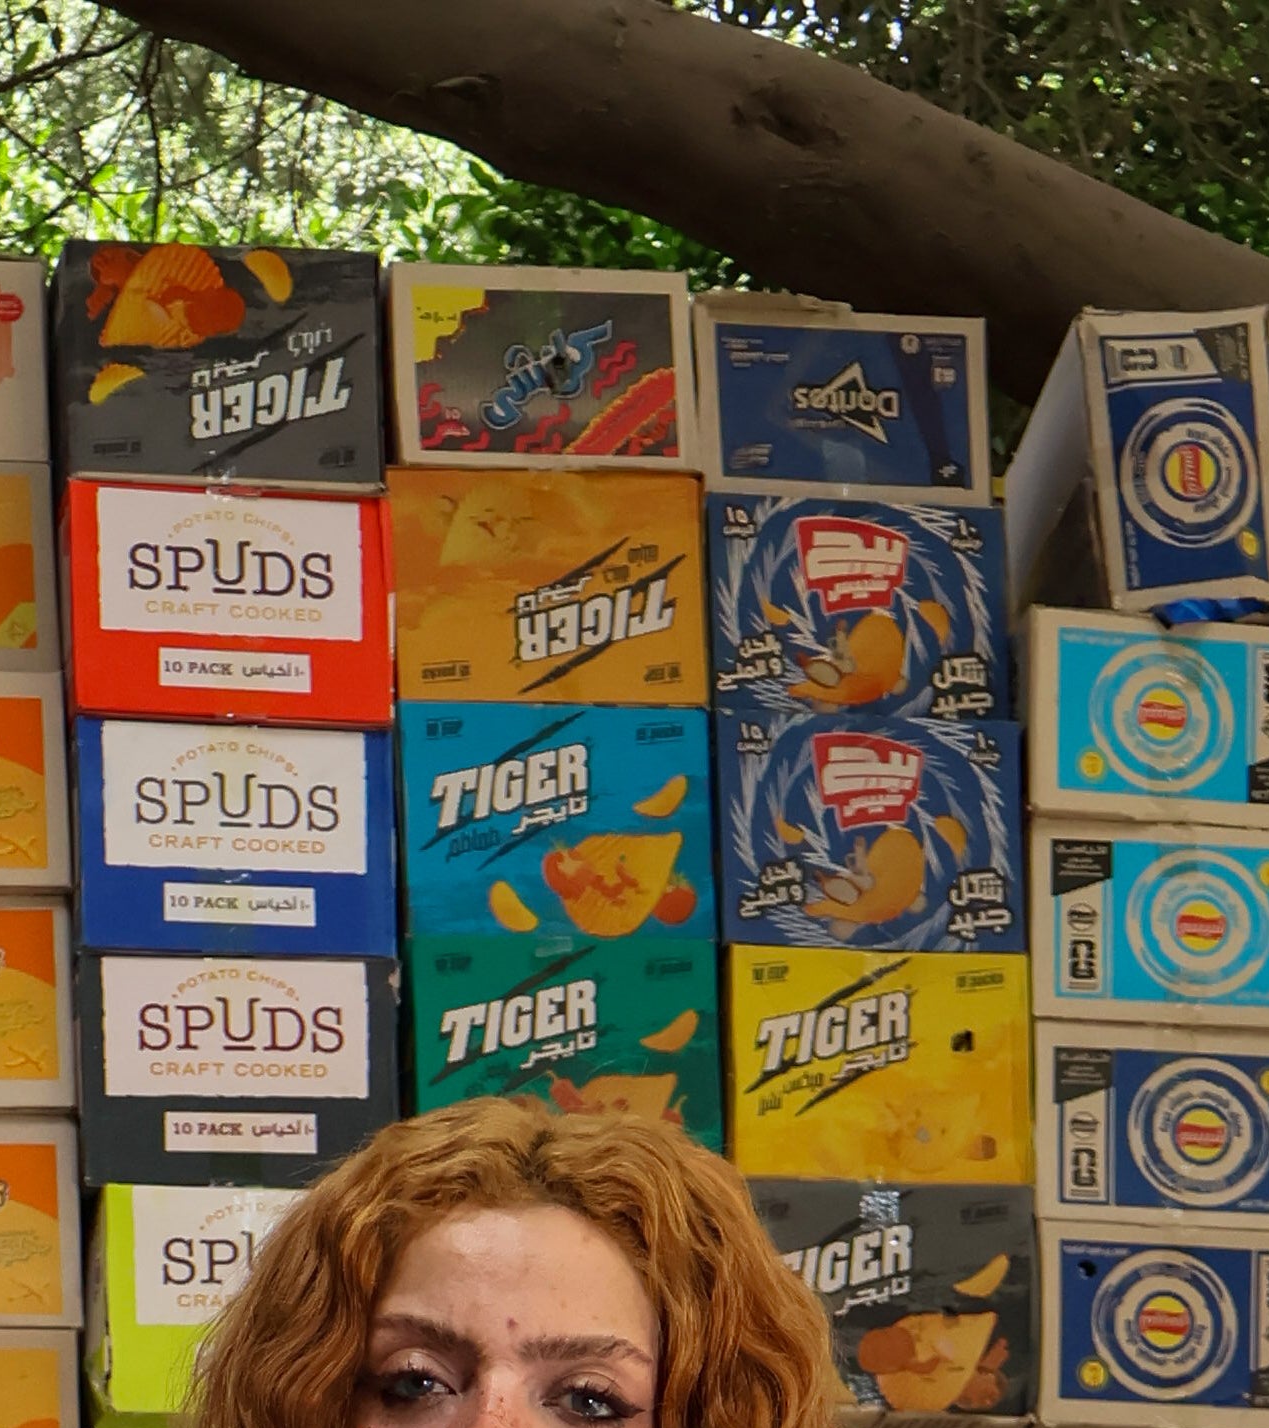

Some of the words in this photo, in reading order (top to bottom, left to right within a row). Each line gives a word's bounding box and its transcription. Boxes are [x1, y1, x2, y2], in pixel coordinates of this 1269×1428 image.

[189, 354, 351, 441] TIGER
[128, 537, 335, 600] SPUDS
[145, 599, 220, 618] CRAFT
[229, 604, 324, 623] COOKED
[514, 576, 676, 666] TIGER
[163, 659, 183, 674] 10
[187, 661, 234, 676] PACK
[176, 741, 239, 767] POTATO
[245, 743, 296, 775] CHIPS
[135, 772, 340, 833] SPUDS
[432, 741, 591, 829] TIGER
[148, 834, 223, 851] CRAFT
[231, 837, 326, 854] COOKED
[170, 895, 189, 908] 10
[194, 896, 240, 910] PACK
[176, 968, 241, 994] POTATO
[246, 970, 298, 1000] CHIPS
[138, 996, 345, 1054] SPUDS
[441, 978, 597, 1064] TIGER
[755, 990, 910, 1074] TIGER
[149, 1061, 225, 1077] CRAFT
[233, 1062, 329, 1079] COOKED
[173, 1122, 192, 1136] 10
[197, 1123, 243, 1137] PACK
